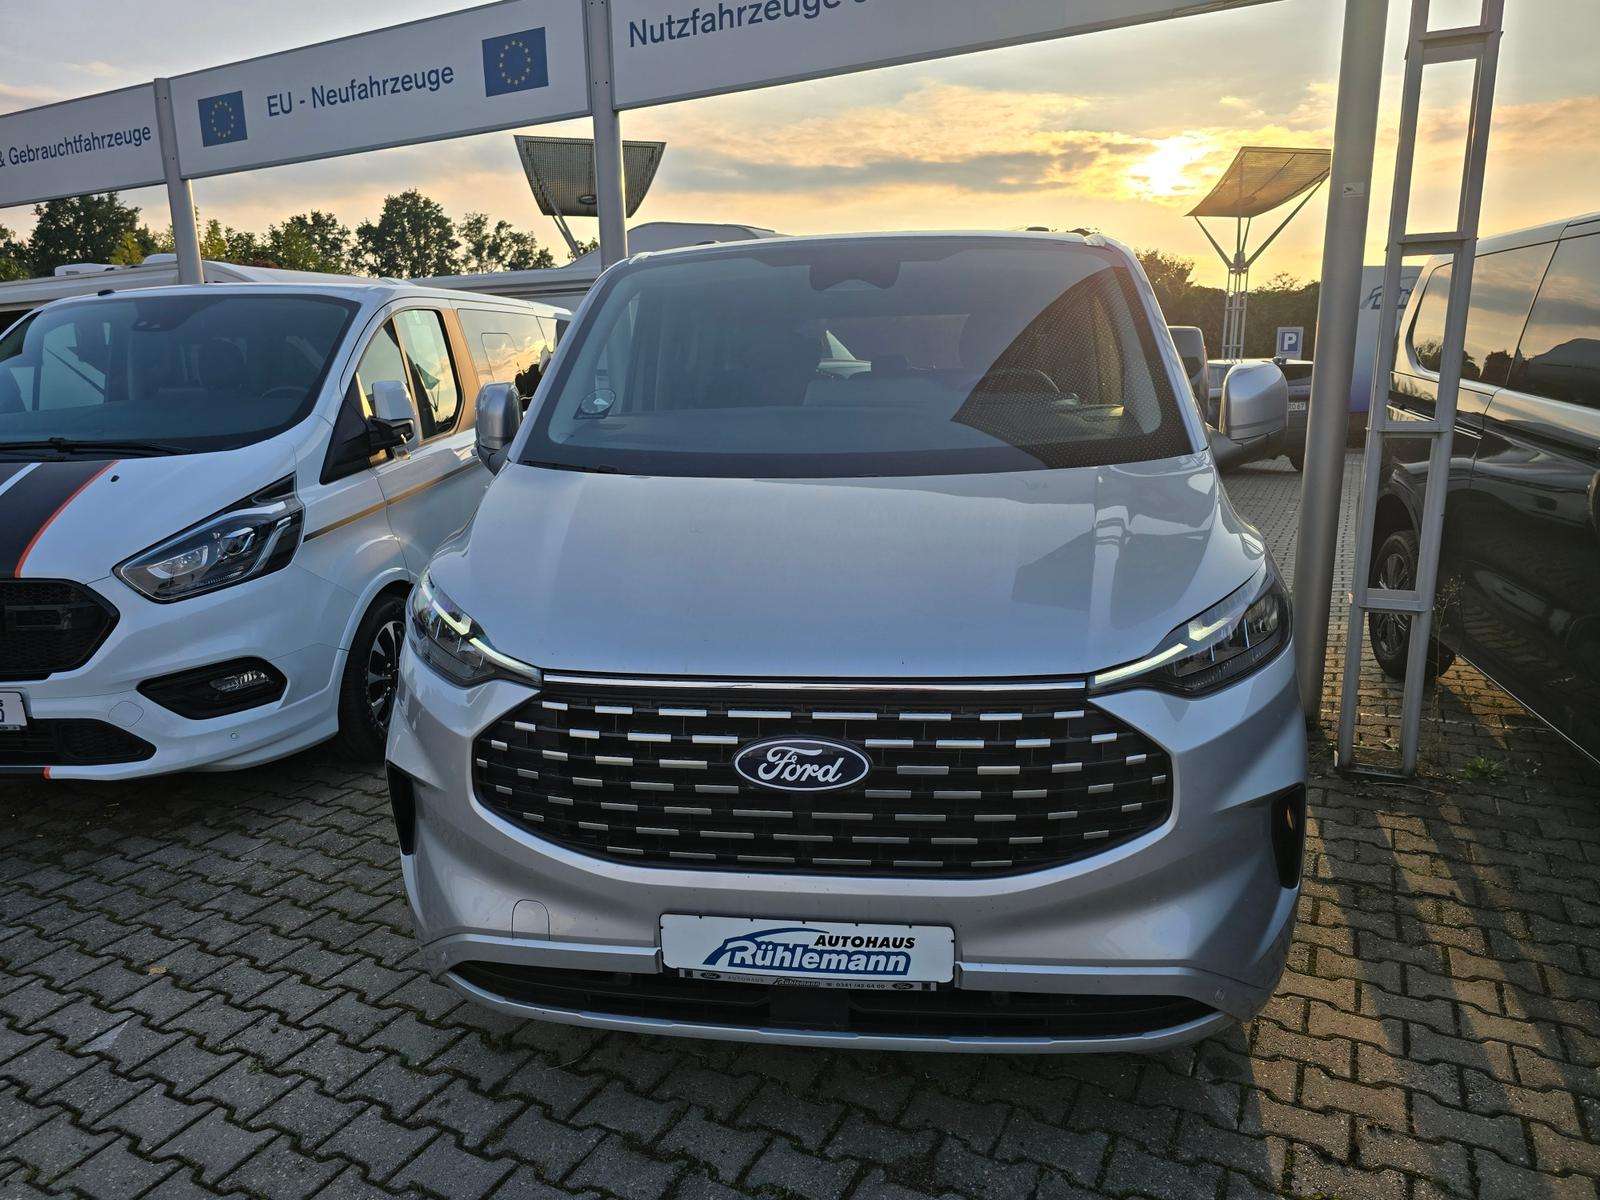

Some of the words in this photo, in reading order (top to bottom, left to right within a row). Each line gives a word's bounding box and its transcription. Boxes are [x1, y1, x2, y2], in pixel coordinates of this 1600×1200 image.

[267, 91, 293, 116] EU
[312, 66, 454, 109] Neufahrzeuge
[9, 126, 152, 165] Gebrauchtfahrzeuge
[1284, 333, 1297, 350] P
[758, 746, 844, 783] Ford
[721, 939, 908, 972] Rühlemann
[814, 934, 915, 949] AUTOHAUS
